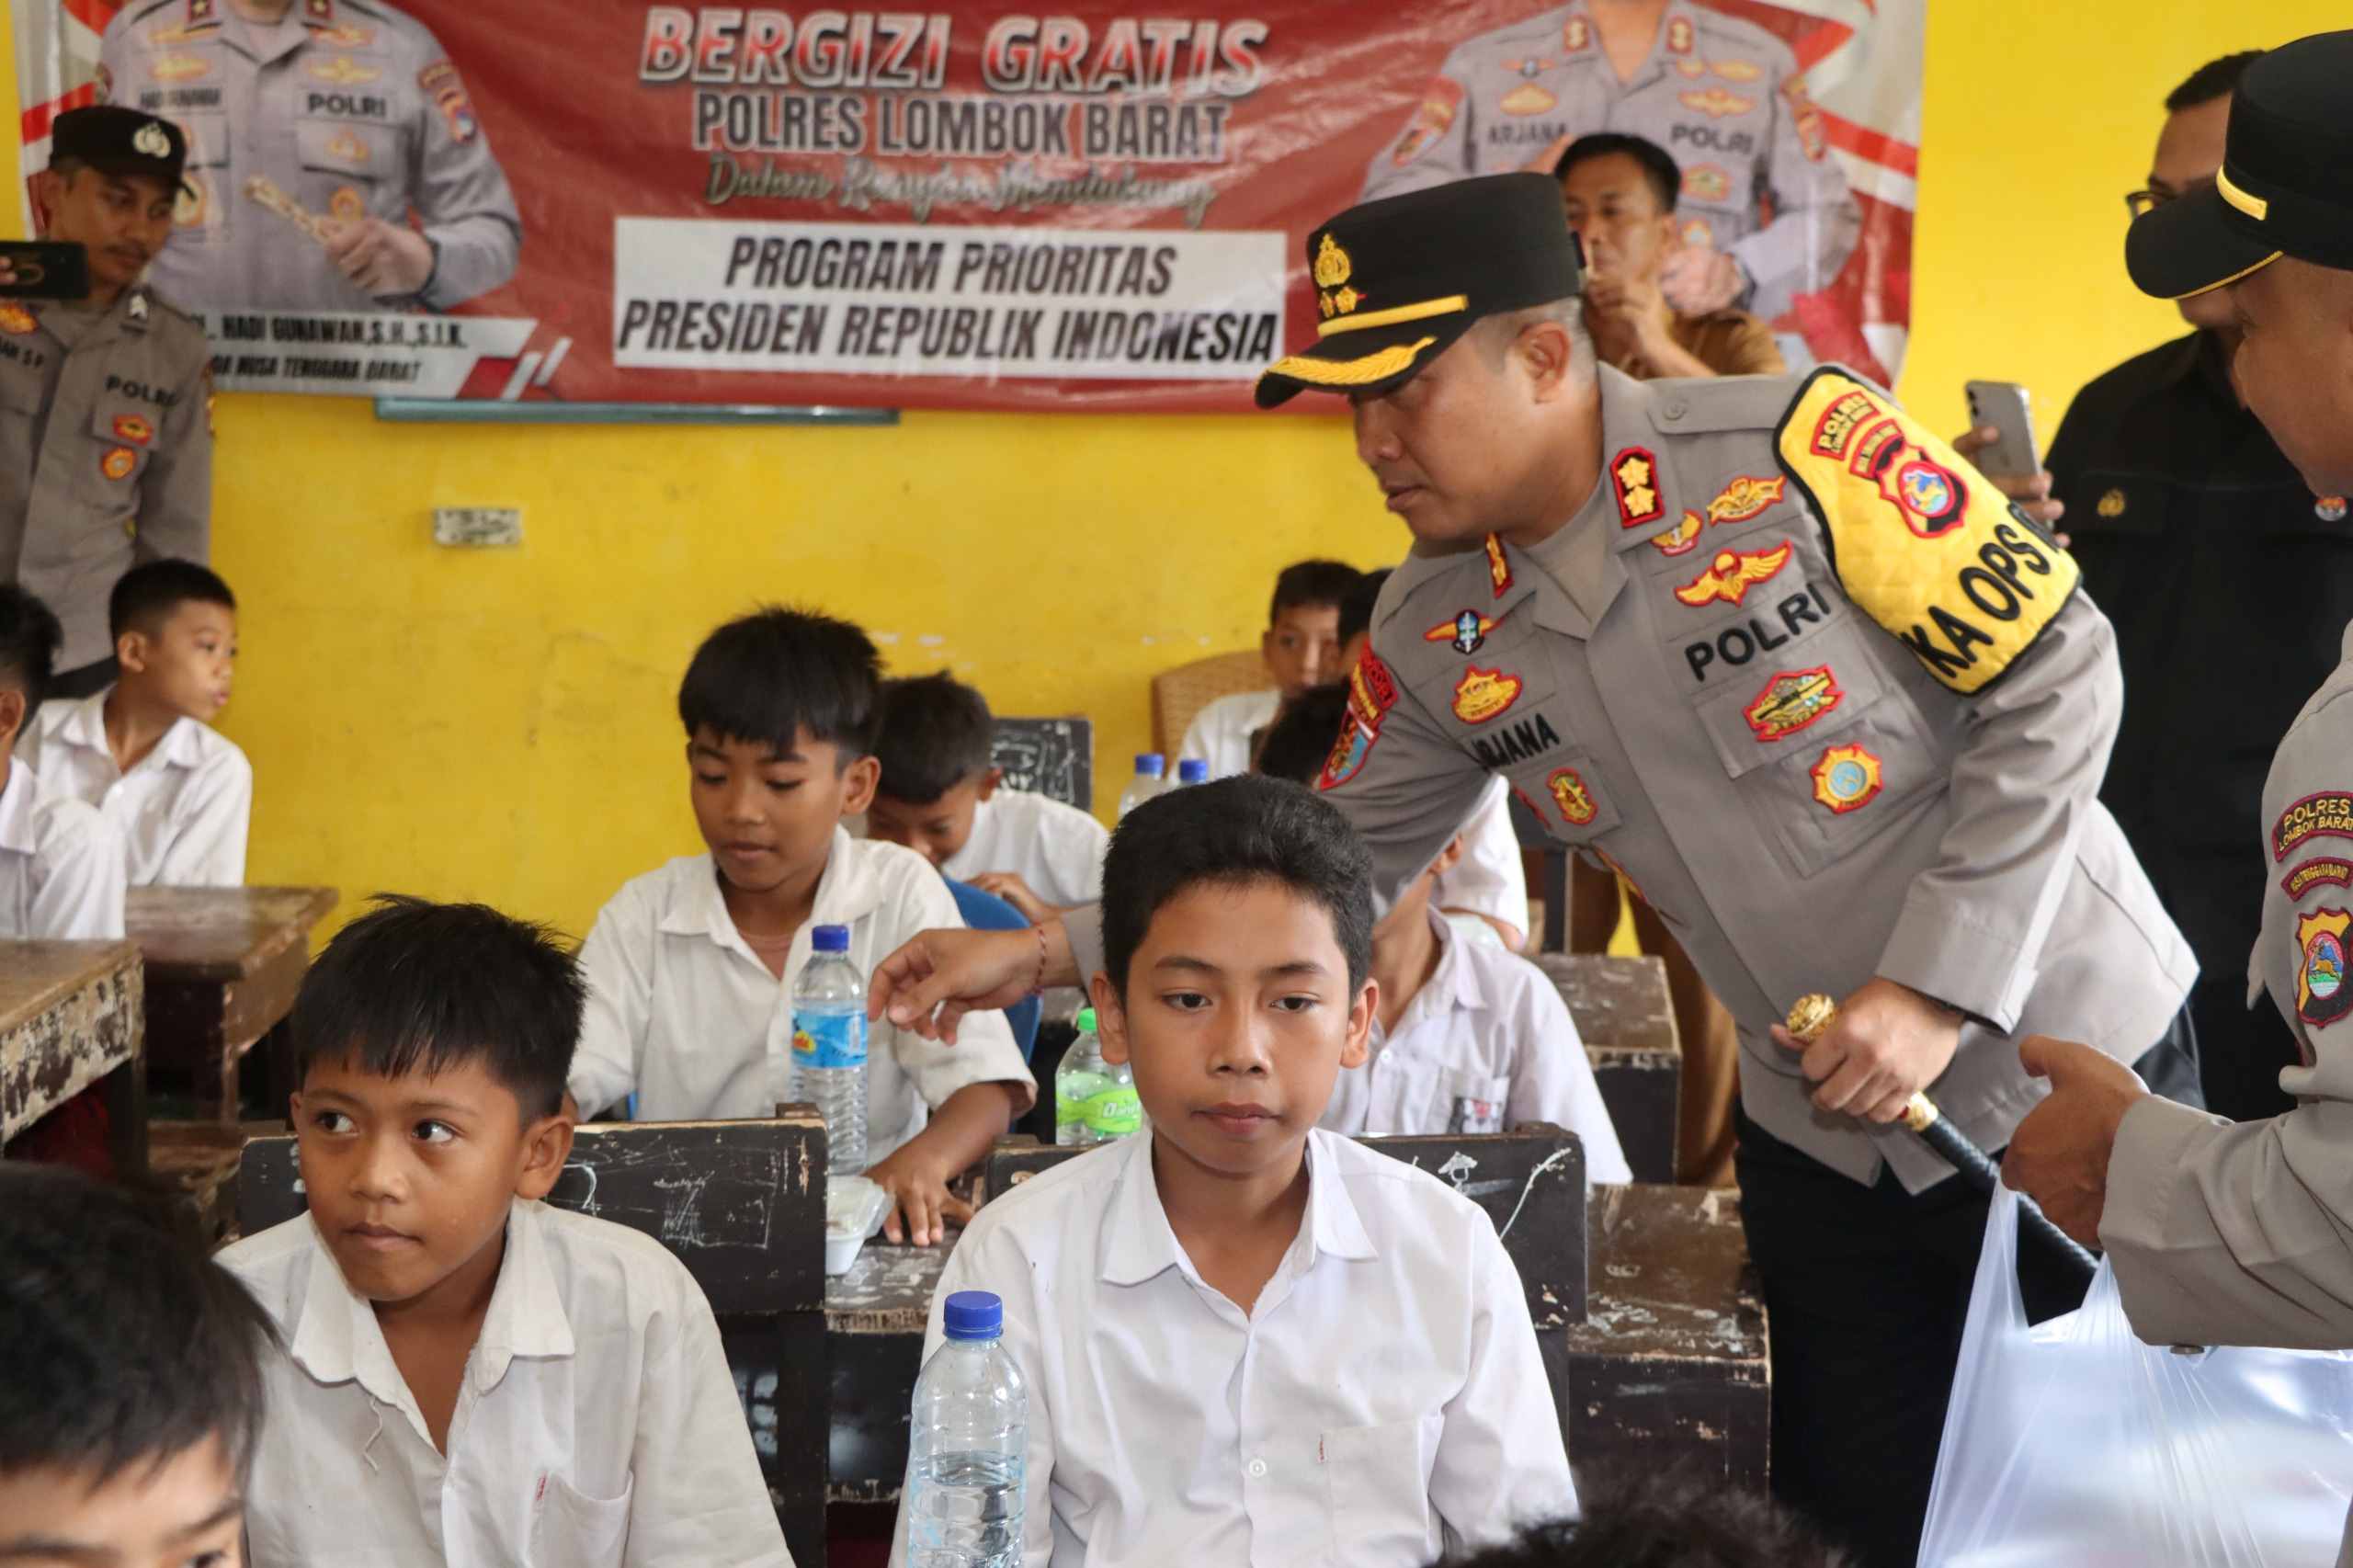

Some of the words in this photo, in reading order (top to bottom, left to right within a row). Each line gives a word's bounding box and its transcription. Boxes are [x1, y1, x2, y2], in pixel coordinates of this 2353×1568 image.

[640, 6, 951, 90] BERGIZI
[982, 15, 1269, 97] GRATIS
[308, 93, 386, 119] POLRI
[693, 89, 866, 154] POLRES
[878, 95, 1071, 158] LOMBOK
[1083, 99, 1230, 164] BARAT
[1670, 124, 1754, 155] POLRI
[705, 153, 832, 205] Dalam
[723, 236, 944, 292] PROGRAM
[953, 242, 1177, 297] PRIORITAS
[617, 299, 828, 355] PRESIDEN
[837, 304, 1038, 361] REPUBLIK
[1051, 310, 1278, 363] INDONESIA
[106, 375, 178, 407] POLRI
[1900, 605, 1995, 679] KA
[1958, 523, 2052, 621] OPS
[1685, 582, 1831, 682] POLRI
[2279, 819, 2315, 853] LOMBOK
[2283, 799, 2351, 831] POLRES
